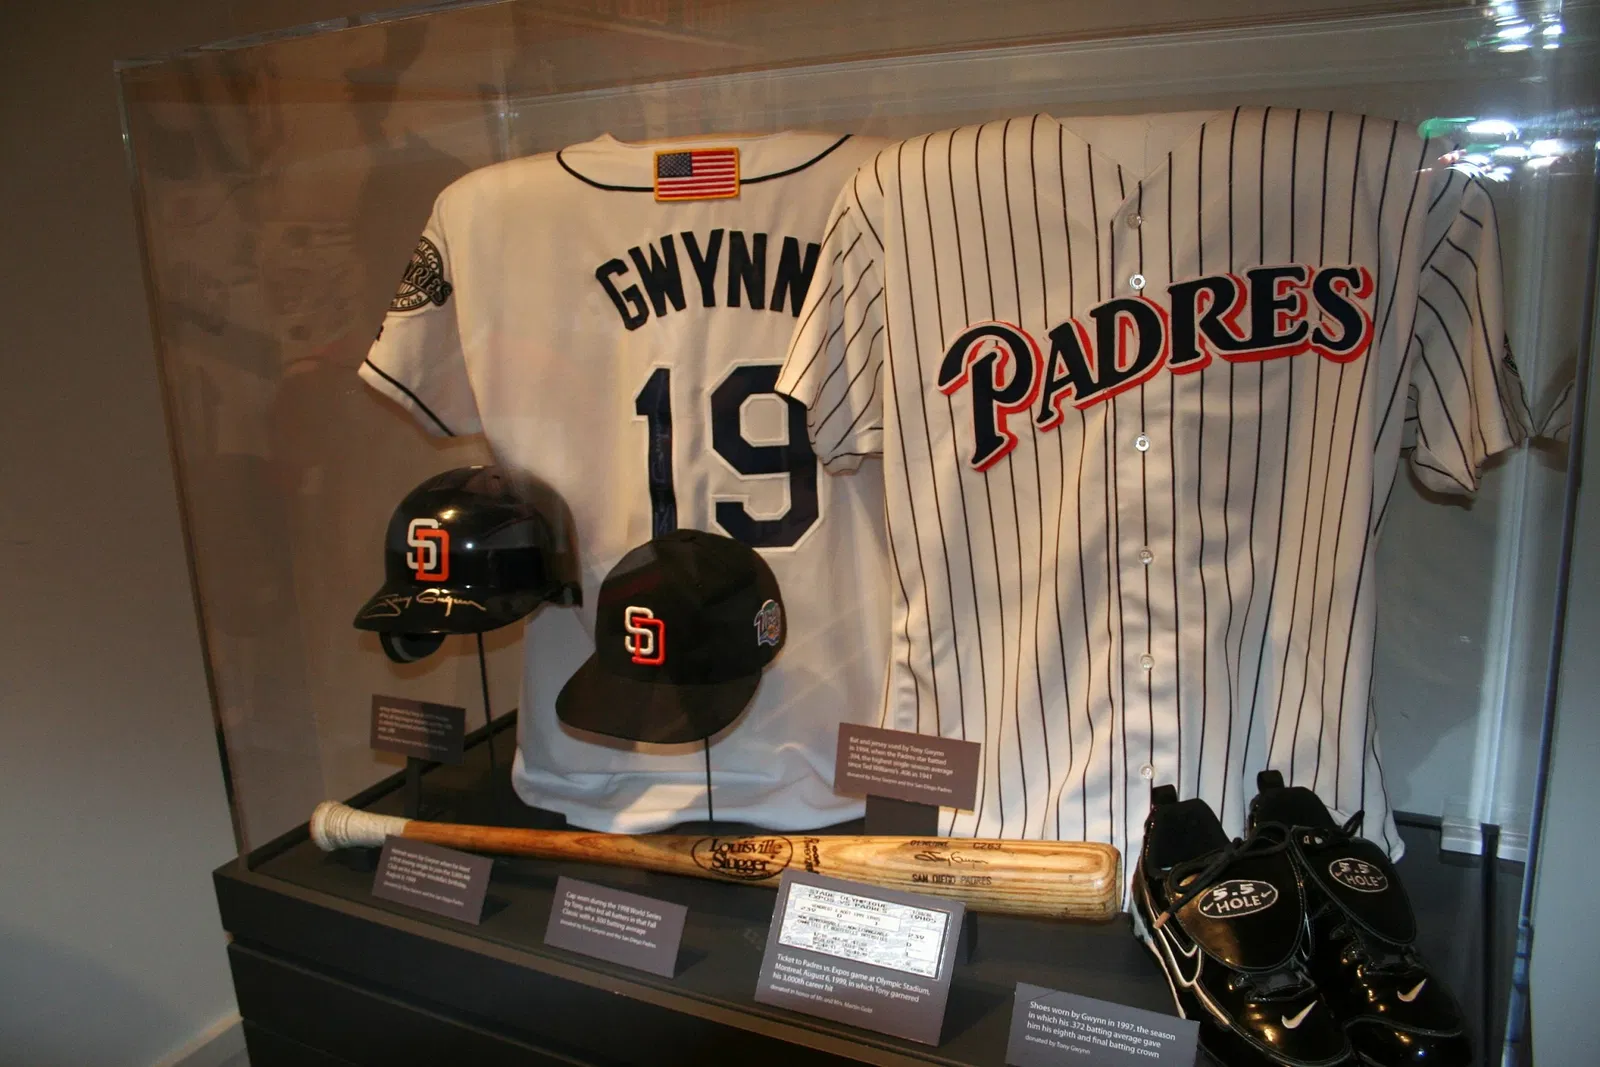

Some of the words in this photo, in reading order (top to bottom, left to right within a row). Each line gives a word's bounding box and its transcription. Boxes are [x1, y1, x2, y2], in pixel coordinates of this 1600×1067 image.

[595, 228, 821, 331] GWYNN
[937, 264, 1374, 472] PADRES
[632, 359, 824, 552] 19
[897, 752, 916, 760] Padres
[910, 746, 923, 754] Tony
[924, 748, 944, 756] Gwynn
[709, 838, 783, 854] Louisville
[711, 852, 769, 874] Slugger
[1338, 861, 1370, 874] 5.5
[912, 873, 929, 883] SAN
[932, 874, 956, 885] DIEGO
[960, 875, 992, 886] PADRES
[1344, 874, 1378, 887] HOLE
[1213, 882, 1255, 901] 5.5
[1215, 895, 1262, 914] HOLE
[772, 971, 782, 980] his
[805, 981, 824, 989] career
[825, 984, 833, 992] hit
[778, 953, 795, 963] Ticket
[803, 959, 822, 970] Padres
[831, 966, 850, 977] Expos
[850, 972, 868, 981] game
[876, 976, 902, 989] Olympic
[903, 982, 930, 996] Stadium,
[803, 969, 825, 980] August
[855, 982, 874, 992] which
[875, 986, 890, 997] Tony
[891, 991, 920, 1002] garnered
[1028, 1011, 1035, 1019] in
[1037, 1014, 1058, 1024] which
[1059, 1018, 1069, 1027] his
[1070, 1022, 1085, 1031] .372
[1086, 1025, 1112, 1038] batting
[1113, 1032, 1142, 1044] average
[1143, 1039, 1161, 1048] gave
[1030, 1001, 1050, 1012] Shoes
[1052, 1008, 1070, 1016] worn
[1071, 1010, 1080, 1020] by
[1081, 1013, 1107, 1025] Gwynn
[1108, 1019, 1115, 1027] in
[1137, 1026, 1149, 1035] the
[1150, 1030, 1176, 1041] season
[1025, 1035, 1048, 1045] donated
[1057, 1041, 1069, 1050] Tony
[1070, 1045, 1090, 1054] Gwynn
[1027, 1021, 1041, 1030] him
[1042, 1025, 1052, 1033] his
[1053, 1028, 1076, 1039] eighth
[1077, 1034, 1091, 1042] and
[1092, 1036, 1108, 1046] final
[1109, 1040, 1135, 1054] batting
[1136, 1048, 1159, 1058] crown
